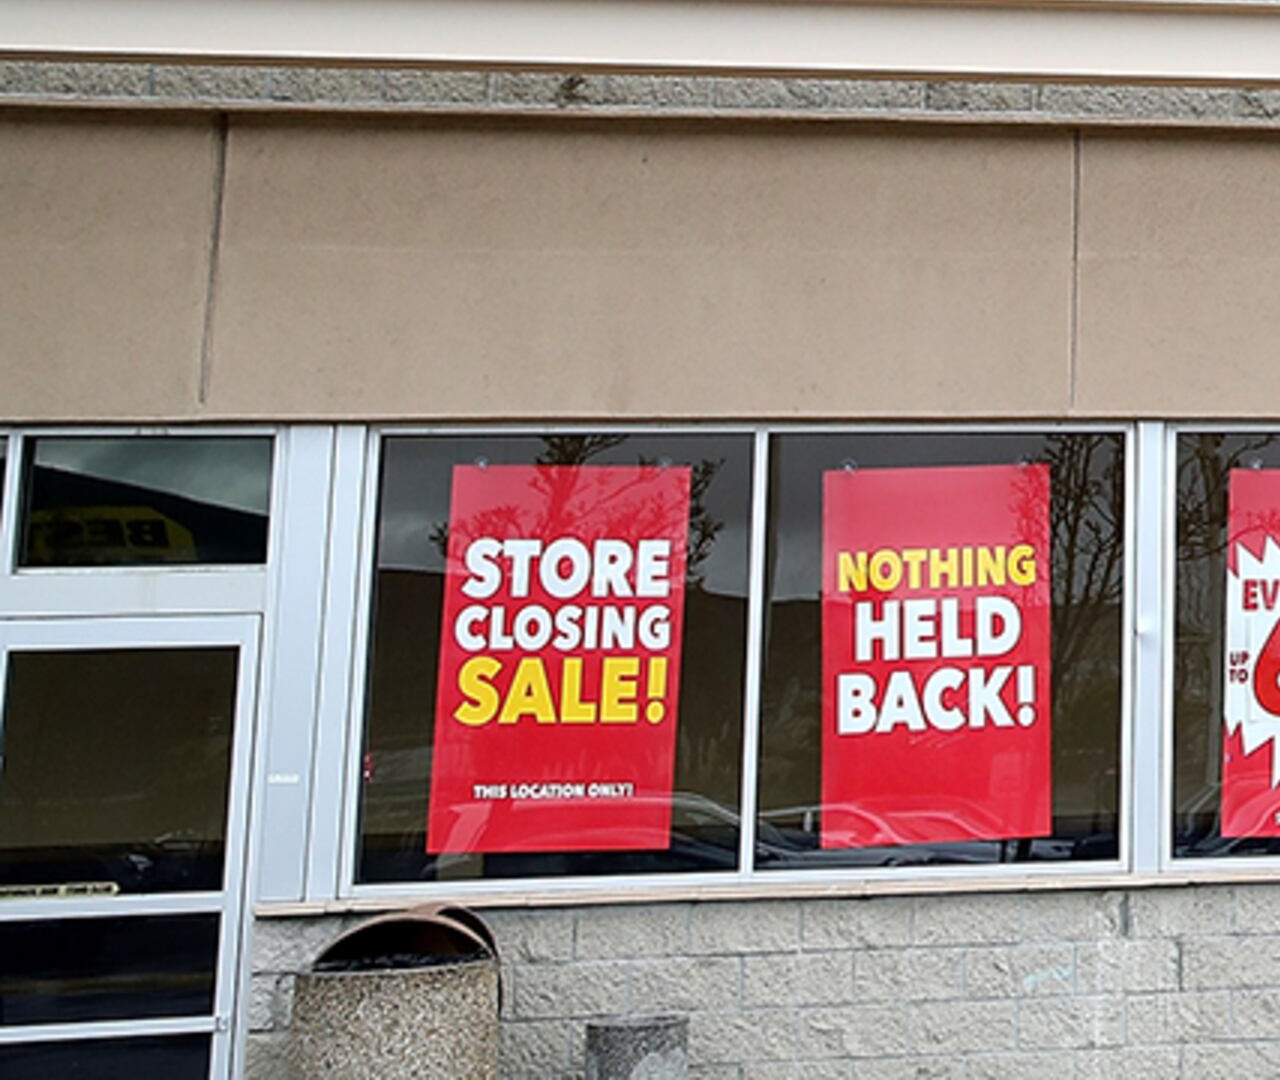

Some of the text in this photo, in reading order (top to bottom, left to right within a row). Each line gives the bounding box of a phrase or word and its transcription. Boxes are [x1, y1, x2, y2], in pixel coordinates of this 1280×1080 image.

[460, 536, 672, 599] STORE
[837, 545, 1037, 592] NOTHING
[454, 604, 671, 651] CLOSING
[853, 597, 1022, 662] HELD
[1229, 651, 1249, 667] UP
[1229, 669, 1249, 685] TO
[453, 656, 668, 726] SALE!
[836, 665, 1036, 736] BACK!
[473, 781, 634, 799] THIS LOCATION ONLY!
